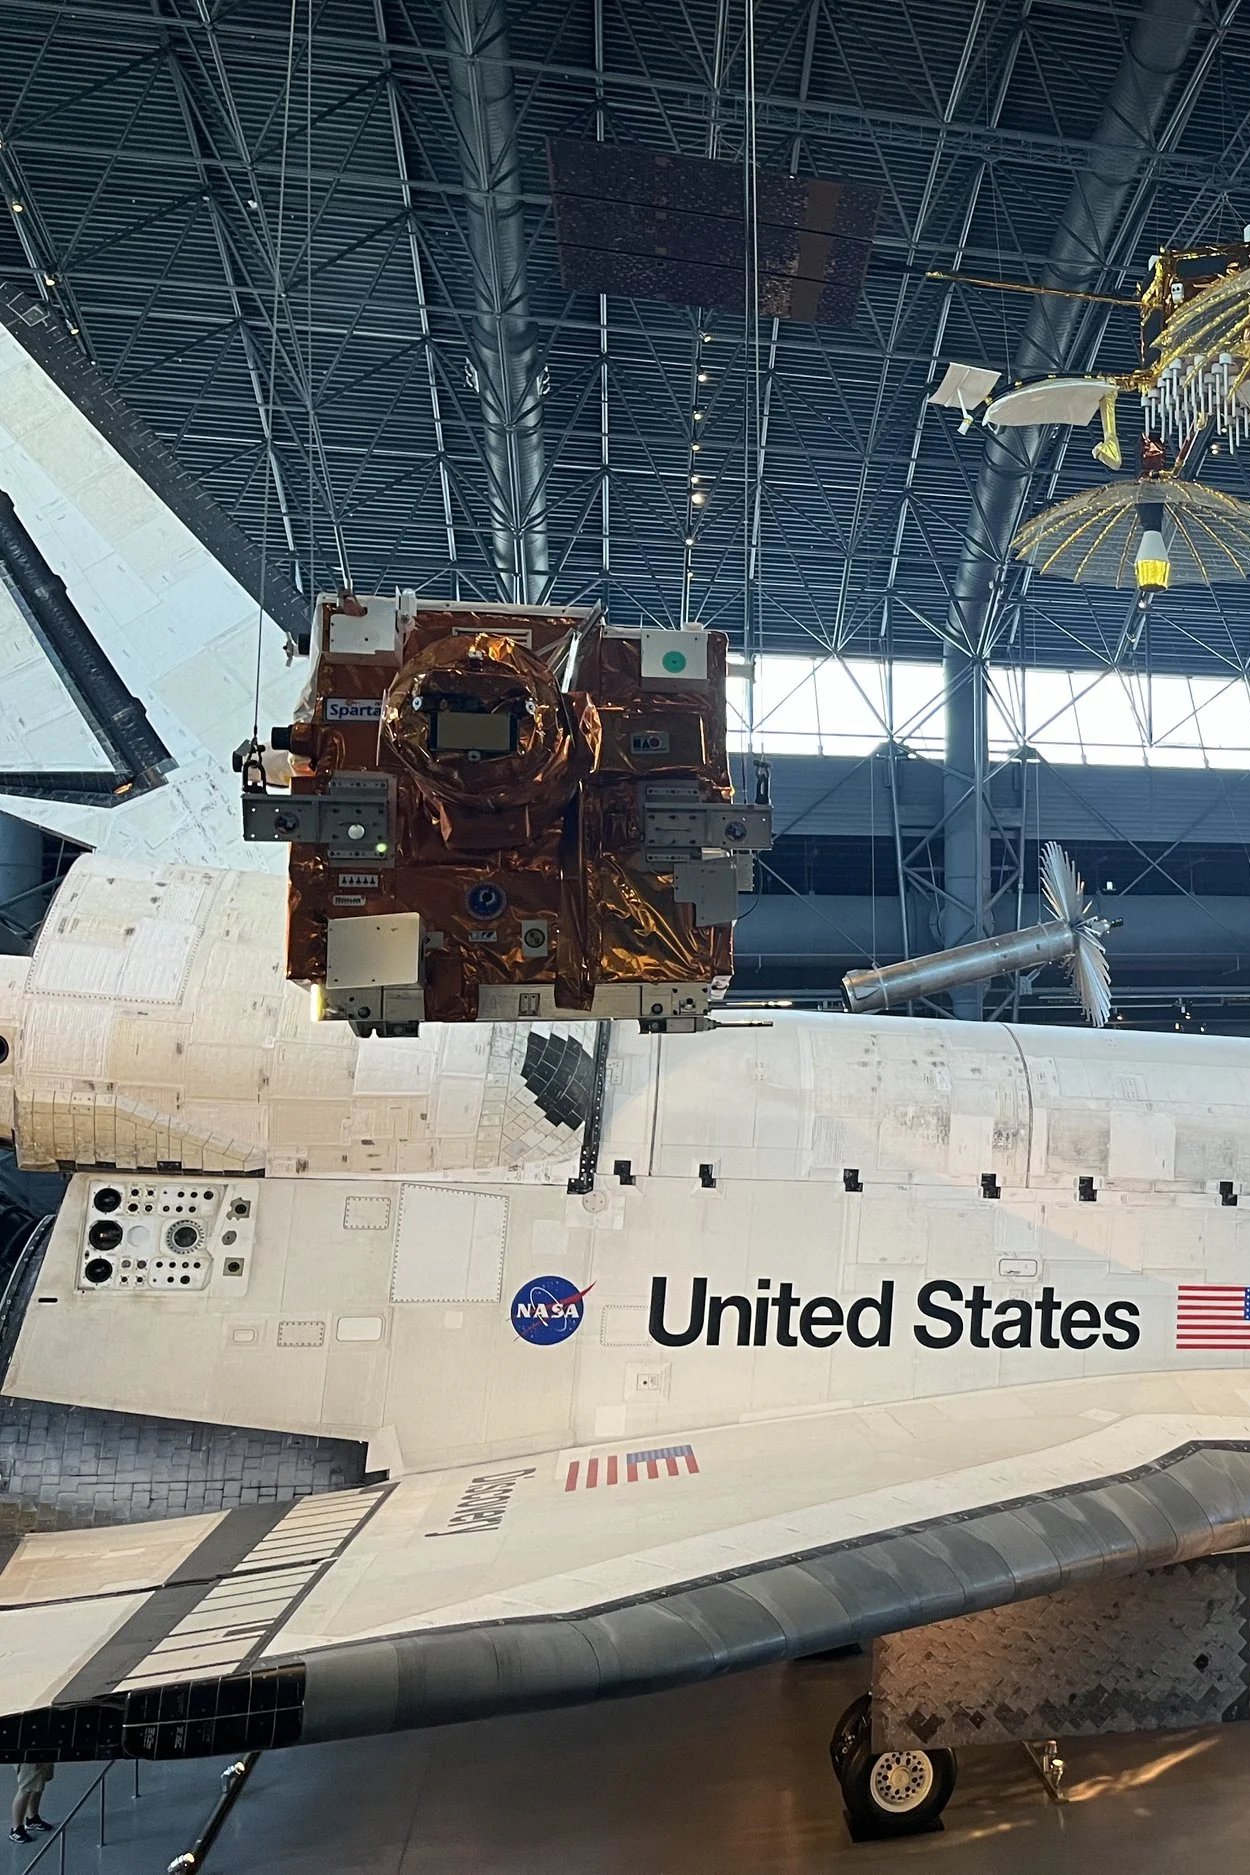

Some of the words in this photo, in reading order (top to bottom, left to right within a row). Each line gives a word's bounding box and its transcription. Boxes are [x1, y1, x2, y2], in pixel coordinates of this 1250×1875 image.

[330, 704, 382, 718] Sparta
[516, 1303, 580, 1319] NASA
[648, 1276, 894, 1348] United
[913, 1279, 1140, 1350] States
[424, 1467, 536, 1537] Discovery
